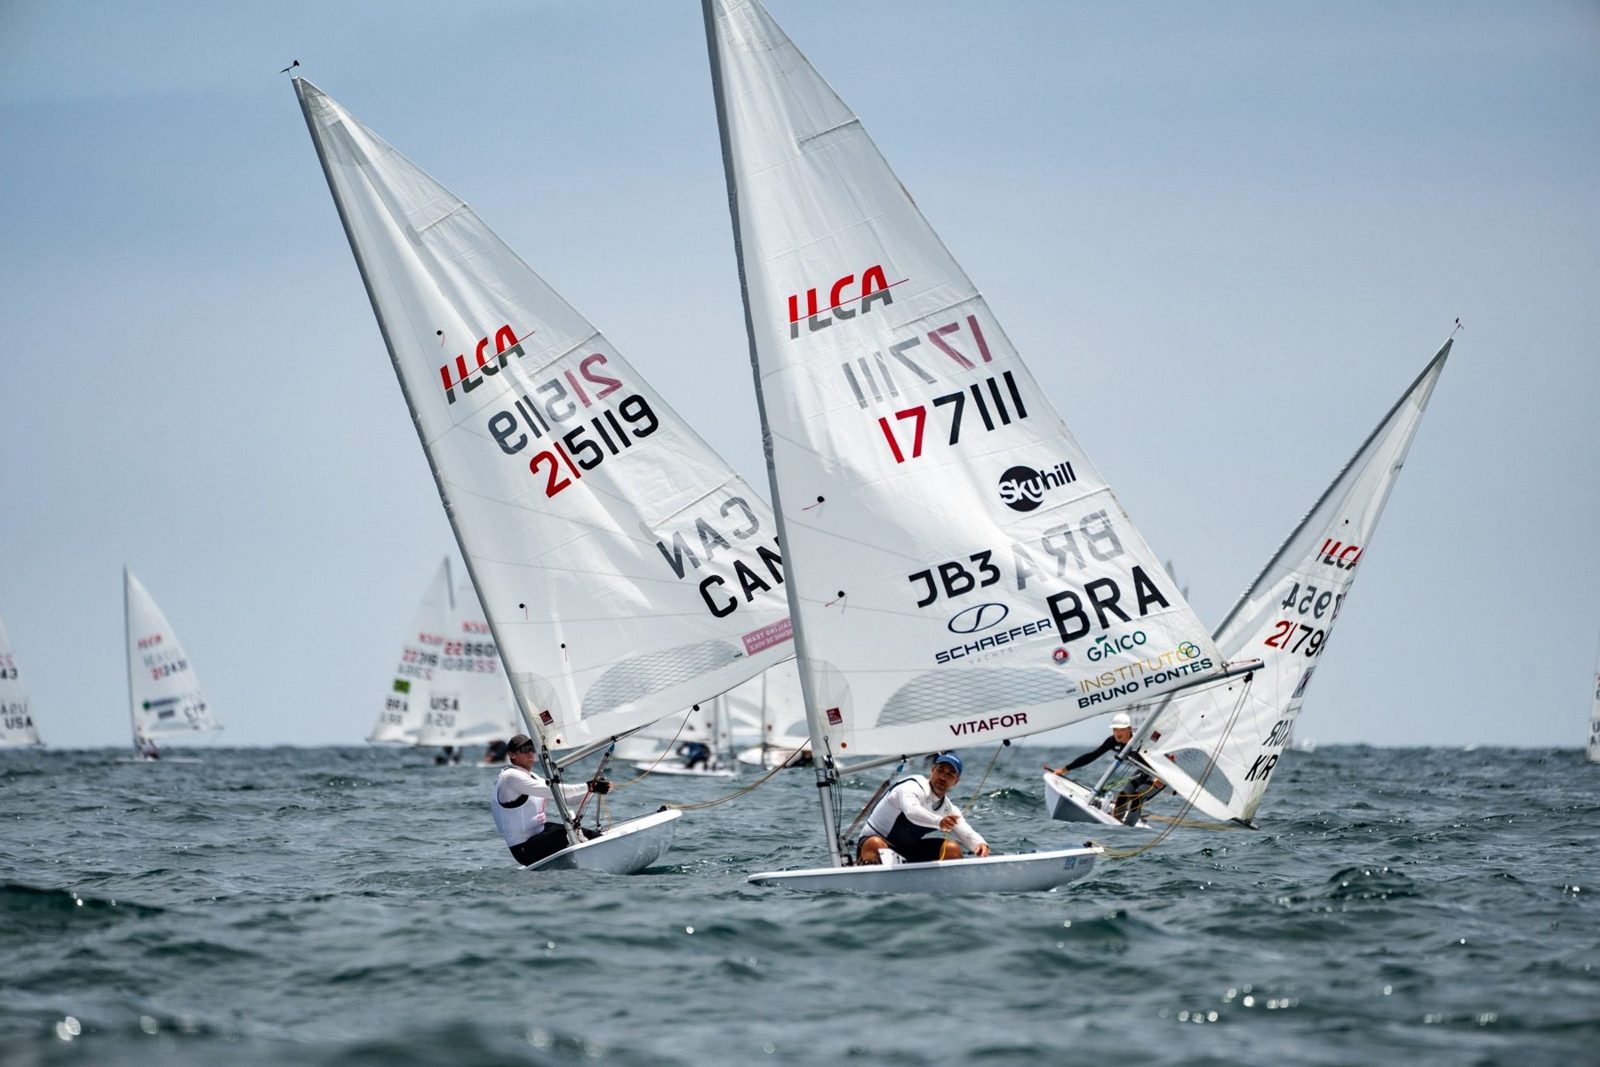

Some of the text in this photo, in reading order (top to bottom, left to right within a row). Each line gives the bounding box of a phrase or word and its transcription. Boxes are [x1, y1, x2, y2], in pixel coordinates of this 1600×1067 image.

[788, 264, 894, 340] ILCA
[439, 324, 526, 406] ILCA
[529, 394, 659, 498] 215119
[878, 370, 1028, 464] 177111
[698, 535, 785, 618] CAN
[908, 549, 1001, 609] JB3
[1046, 565, 1171, 644] BRA
[935, 618, 1053, 664] SCHAEFER
[1078, 658, 1213, 709] BRUNO FONTES
[5, 715, 34, 730] USA
[949, 712, 1028, 736] VITAFOR
